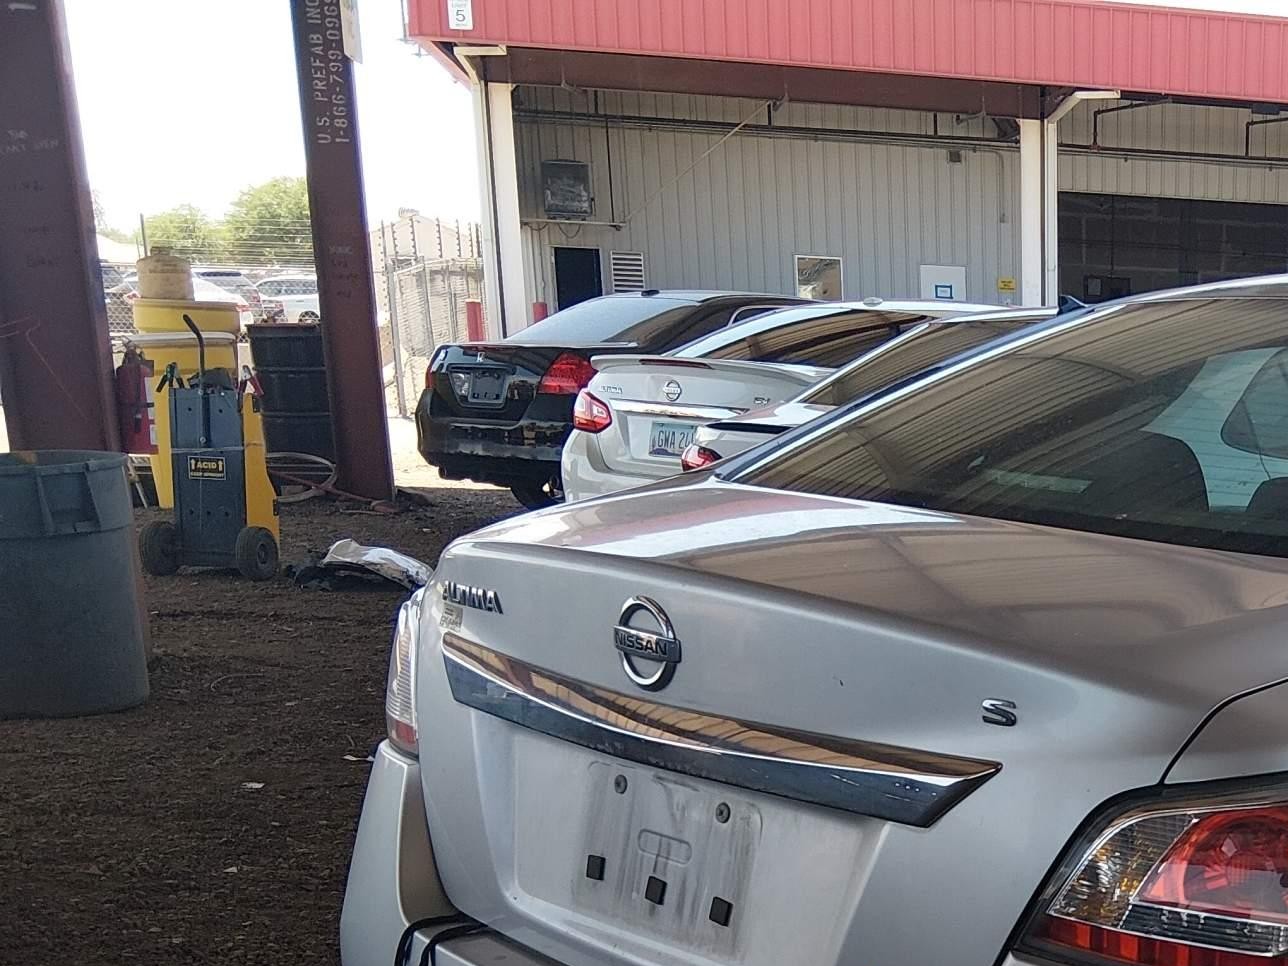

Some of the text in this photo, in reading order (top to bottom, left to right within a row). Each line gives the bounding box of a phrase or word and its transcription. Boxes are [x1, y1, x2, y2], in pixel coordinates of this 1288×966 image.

[455, 9, 466, 22] 5
[308, 33, 329, 101] PREFAB
[316, 111, 332, 144] U.S.
[657, 430, 676, 449] GWA
[197, 461, 218, 469] ACID
[442, 580, 504, 615] ALTIMA
[614, 629, 669, 657] NISSAN
[981, 697, 1017, 727] S
